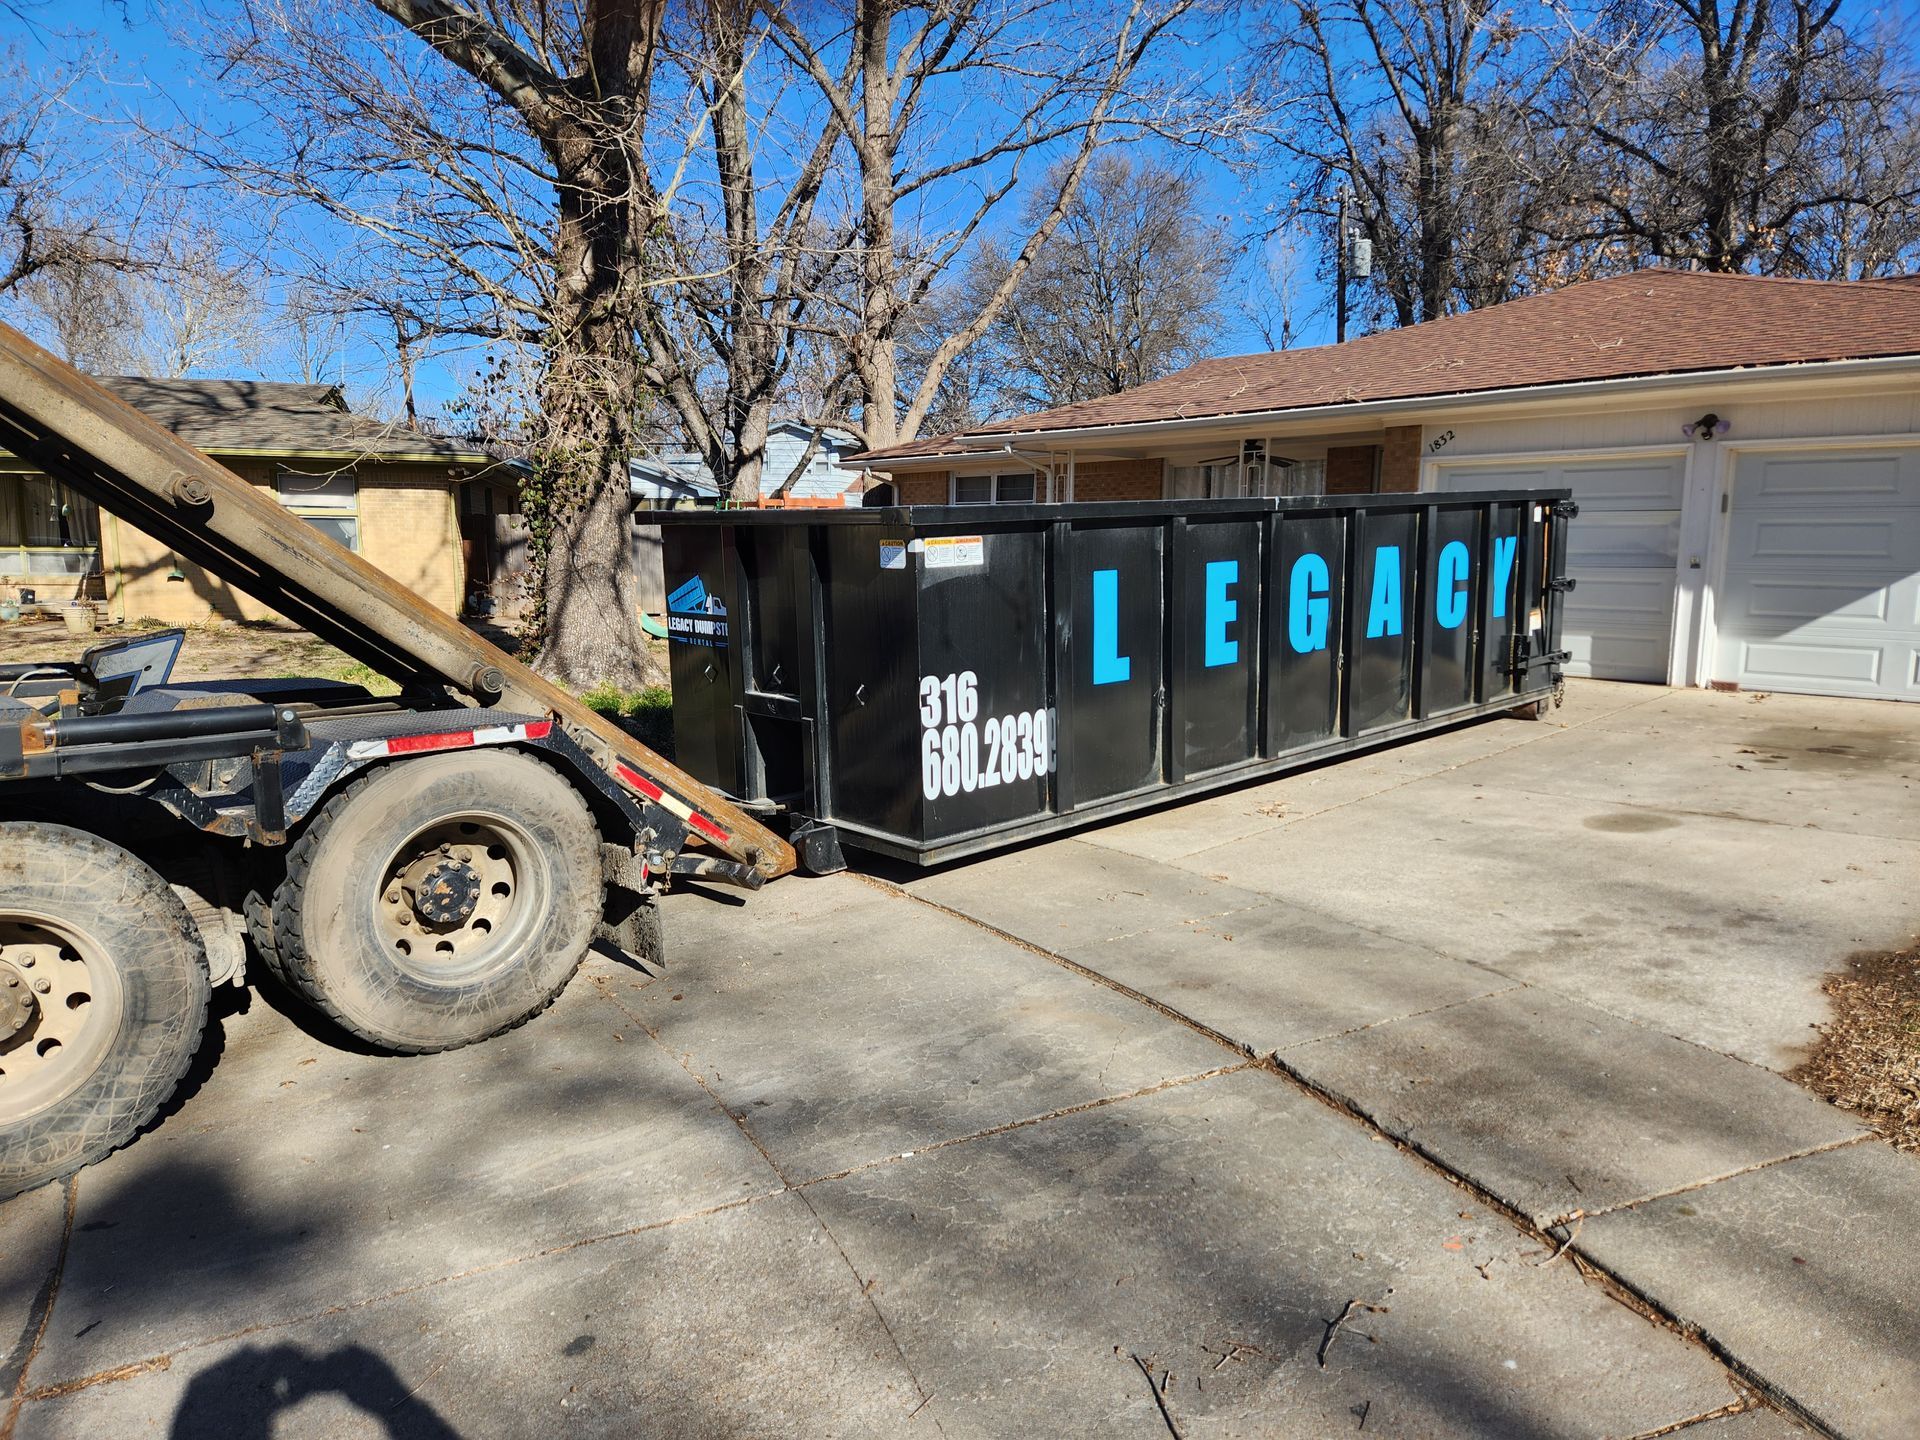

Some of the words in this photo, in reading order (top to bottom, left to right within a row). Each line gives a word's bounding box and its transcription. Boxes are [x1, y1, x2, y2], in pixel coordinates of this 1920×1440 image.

[1429, 430, 1455, 453] 1832
[668, 616, 693, 632] LEGACY
[1093, 536, 1517, 685] LEGACY
[920, 670, 978, 728] 316
[922, 709, 1048, 800] 680.2839
